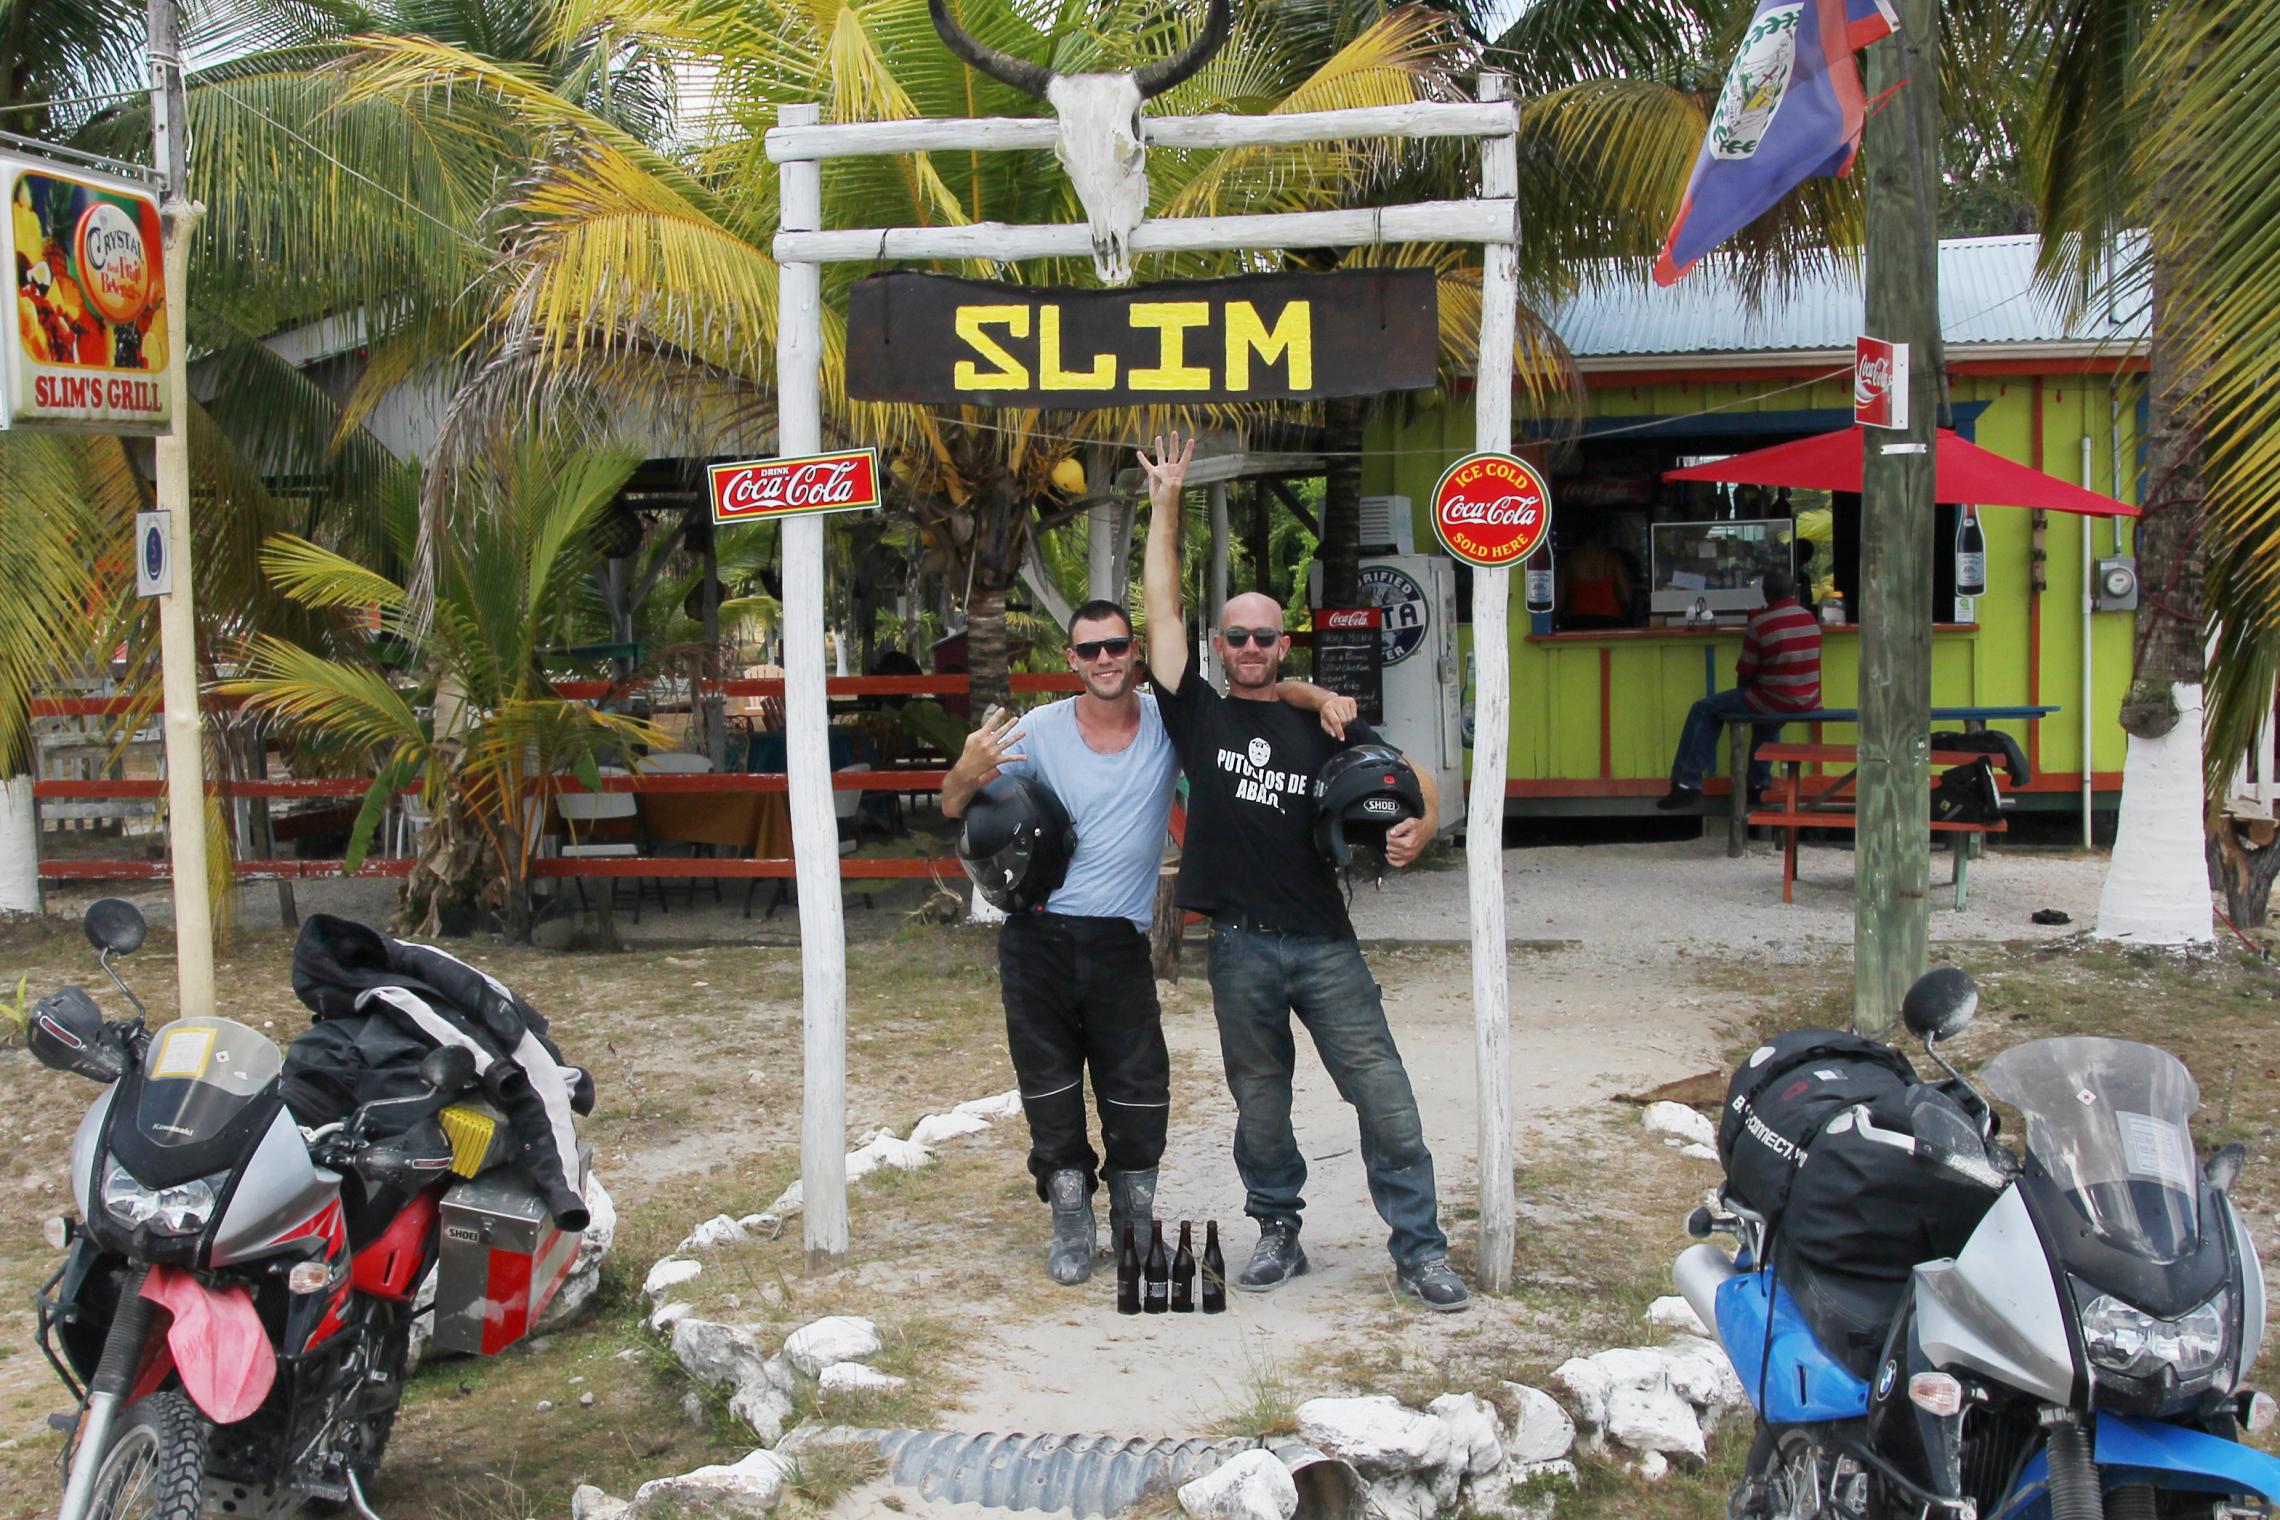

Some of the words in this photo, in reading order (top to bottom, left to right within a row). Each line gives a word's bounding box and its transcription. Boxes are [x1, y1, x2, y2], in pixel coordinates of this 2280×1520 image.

[87, 227, 144, 270] CRYSTAL
[119, 256, 141, 284] Fruit
[954, 300, 1312, 391] SLIM
[1860, 353, 1888, 387] Coca-Cola
[35, 375, 102, 409] SLIM'S
[107, 377, 162, 413] GRILL
[761, 466, 789, 477] DRINK
[1455, 465, 1482, 488] ICE
[1485, 463, 1528, 489] COLD
[722, 461, 858, 511] Coca-Cola
[1442, 495, 1540, 525] Coca-Cola
[1453, 532, 1488, 557] SOLD
[1492, 533, 1528, 558] HERE
[1357, 571, 1412, 595] RIFIED
[1329, 611, 1369, 626] Coca-Cola
[1287, 773, 1307, 795] DE
[1368, 799, 1396, 811] SHOEI
[152, 1123, 194, 1137] Kawasaki
[449, 1228, 478, 1242] SHOEI
